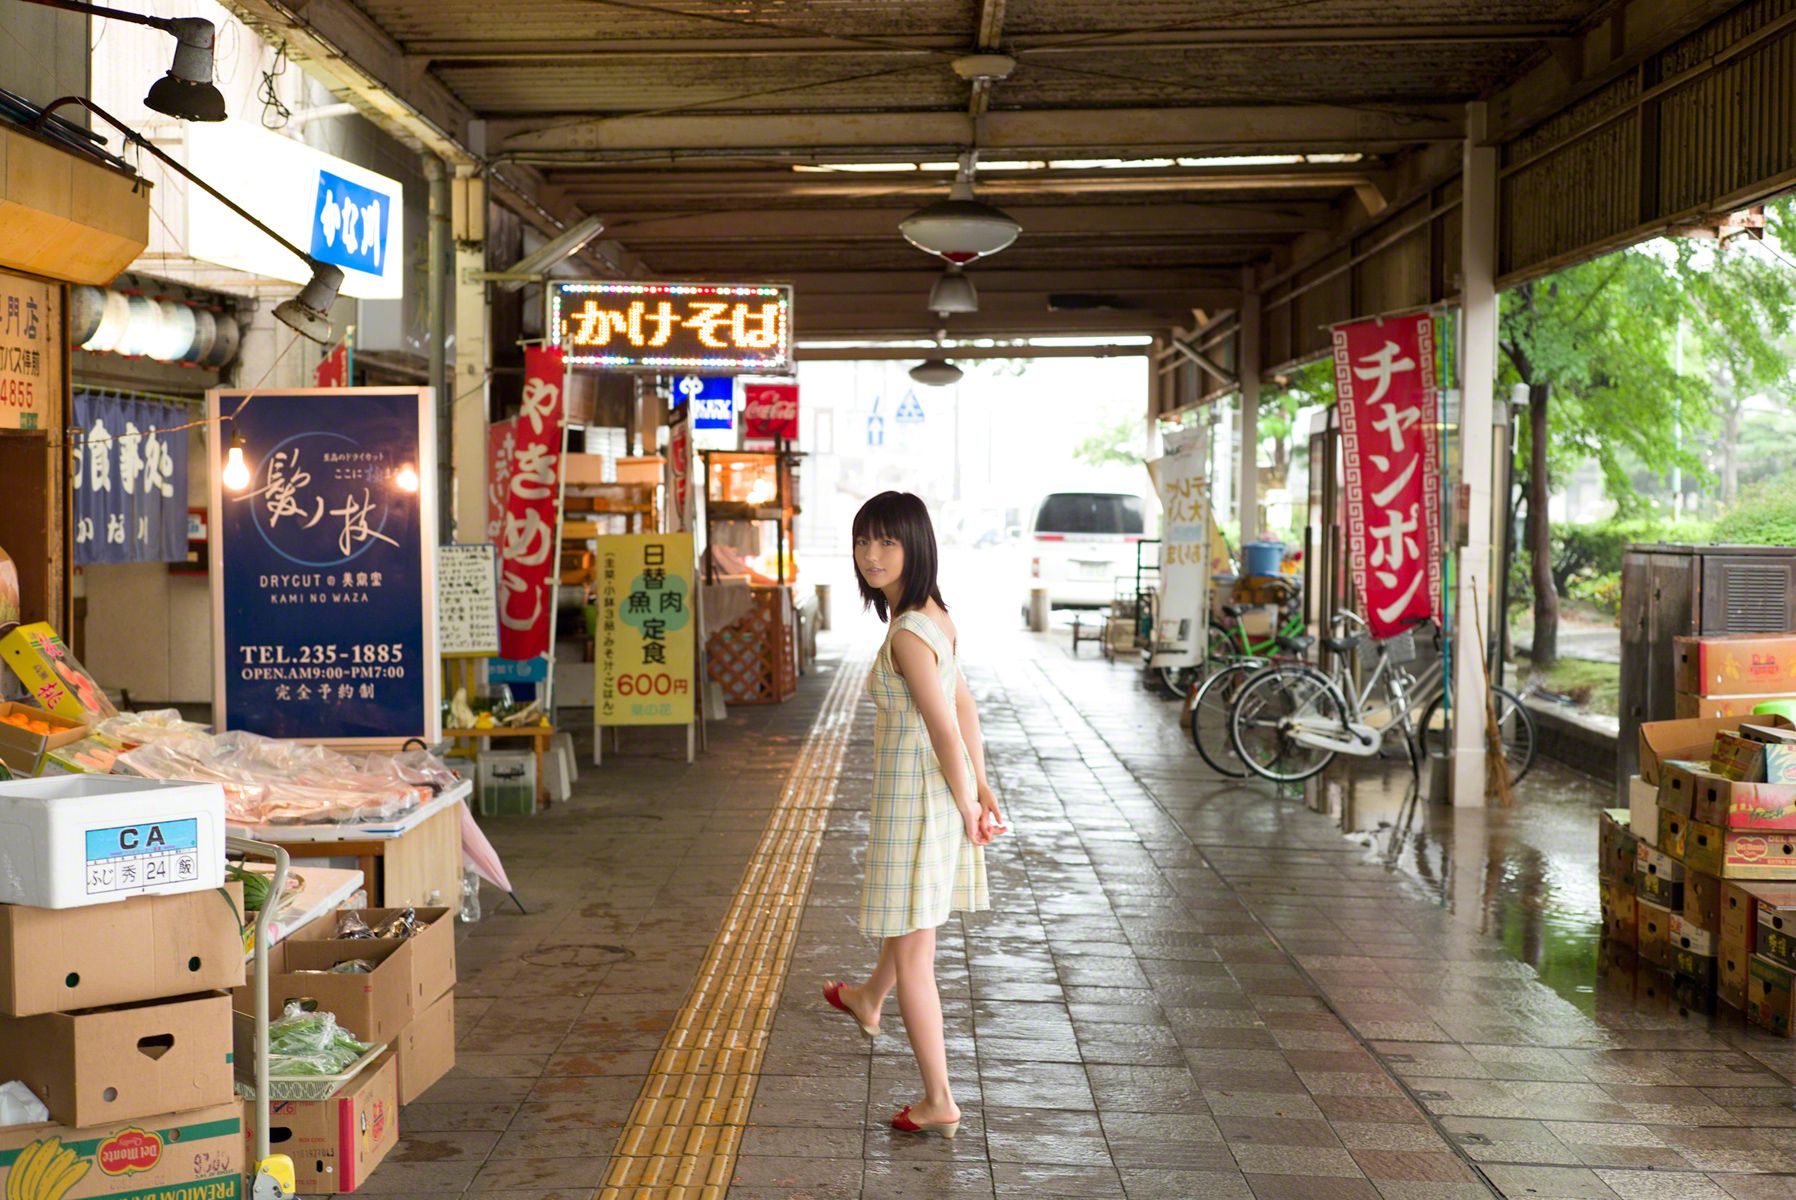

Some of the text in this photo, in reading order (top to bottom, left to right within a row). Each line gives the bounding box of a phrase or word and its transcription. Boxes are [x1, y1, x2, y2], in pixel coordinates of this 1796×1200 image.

[0, 294, 38, 340] 門店
[571, 300, 779, 348] かけそば
[1353, 340, 1424, 624] チャンポン
[500, 377, 560, 631] やきめし
[259, 574, 321, 588] DRYCUT
[271, 592, 369, 604] KAMI NO WAZA
[239, 643, 403, 665] TEL.235-1885
[641, 618, 666, 665] 定食
[274, 683, 375, 701] 完全予約制
[617, 673, 689, 697] 600円
[87, 868, 114, 886] ふじ
[122, 864, 136, 884] 秀
[146, 860, 166, 880] 24
[102, 1144, 157, 1163] Del Monte
